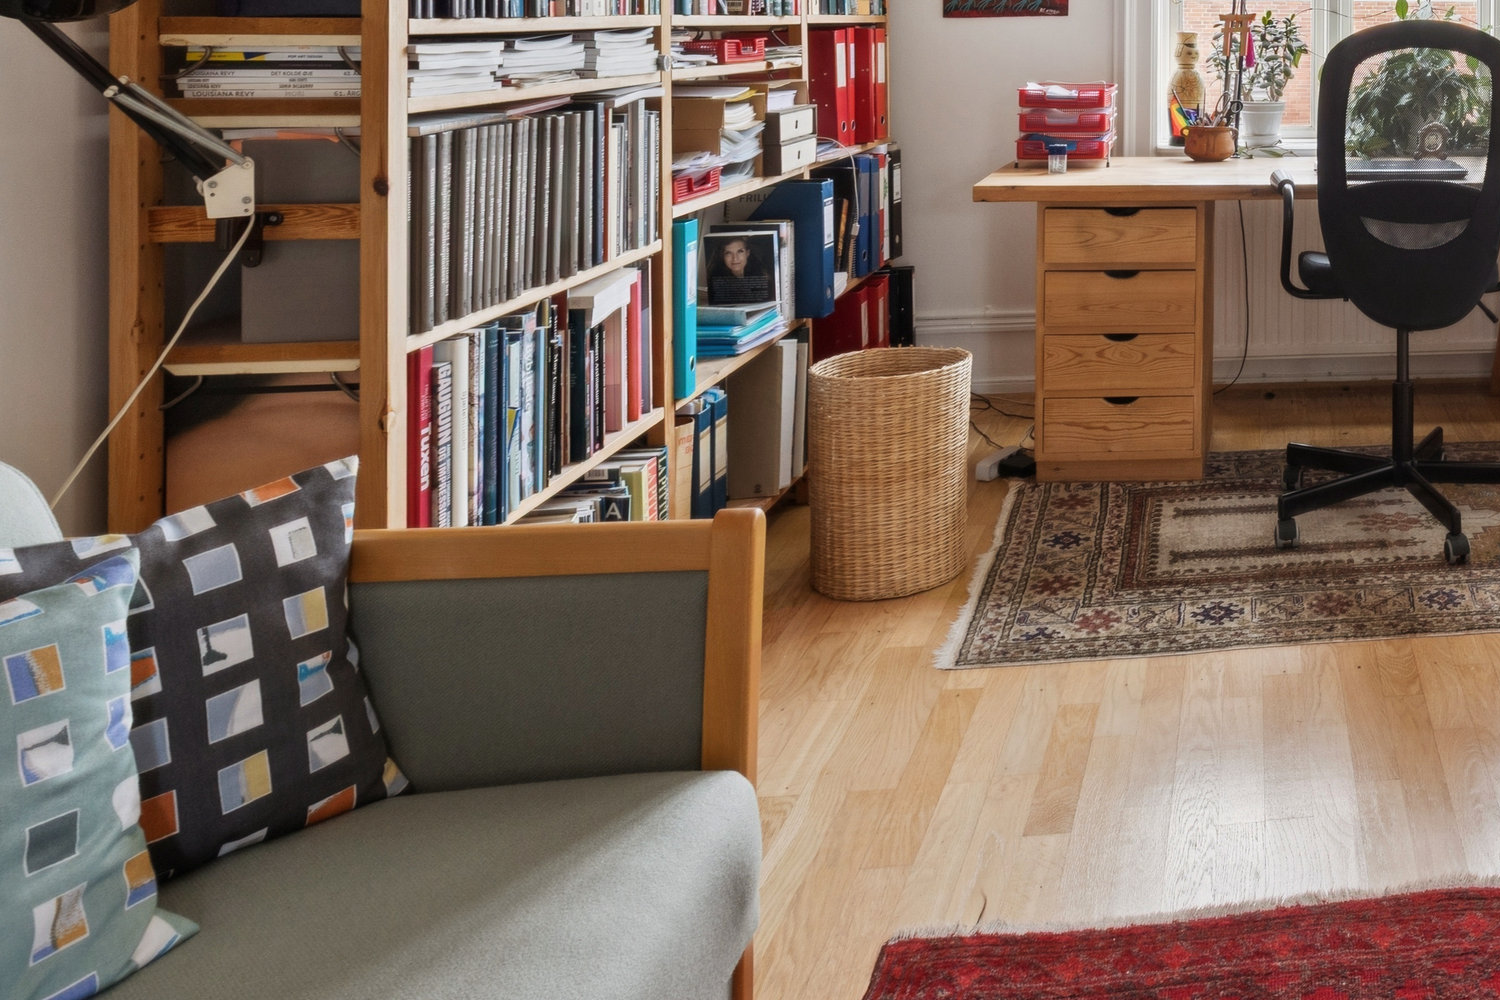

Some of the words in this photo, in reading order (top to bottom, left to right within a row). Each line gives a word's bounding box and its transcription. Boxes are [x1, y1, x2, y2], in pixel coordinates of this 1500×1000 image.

[438, 363, 452, 446] GAUGUIN
[420, 422, 432, 491] Tuxen
[605, 502, 622, 519] A
